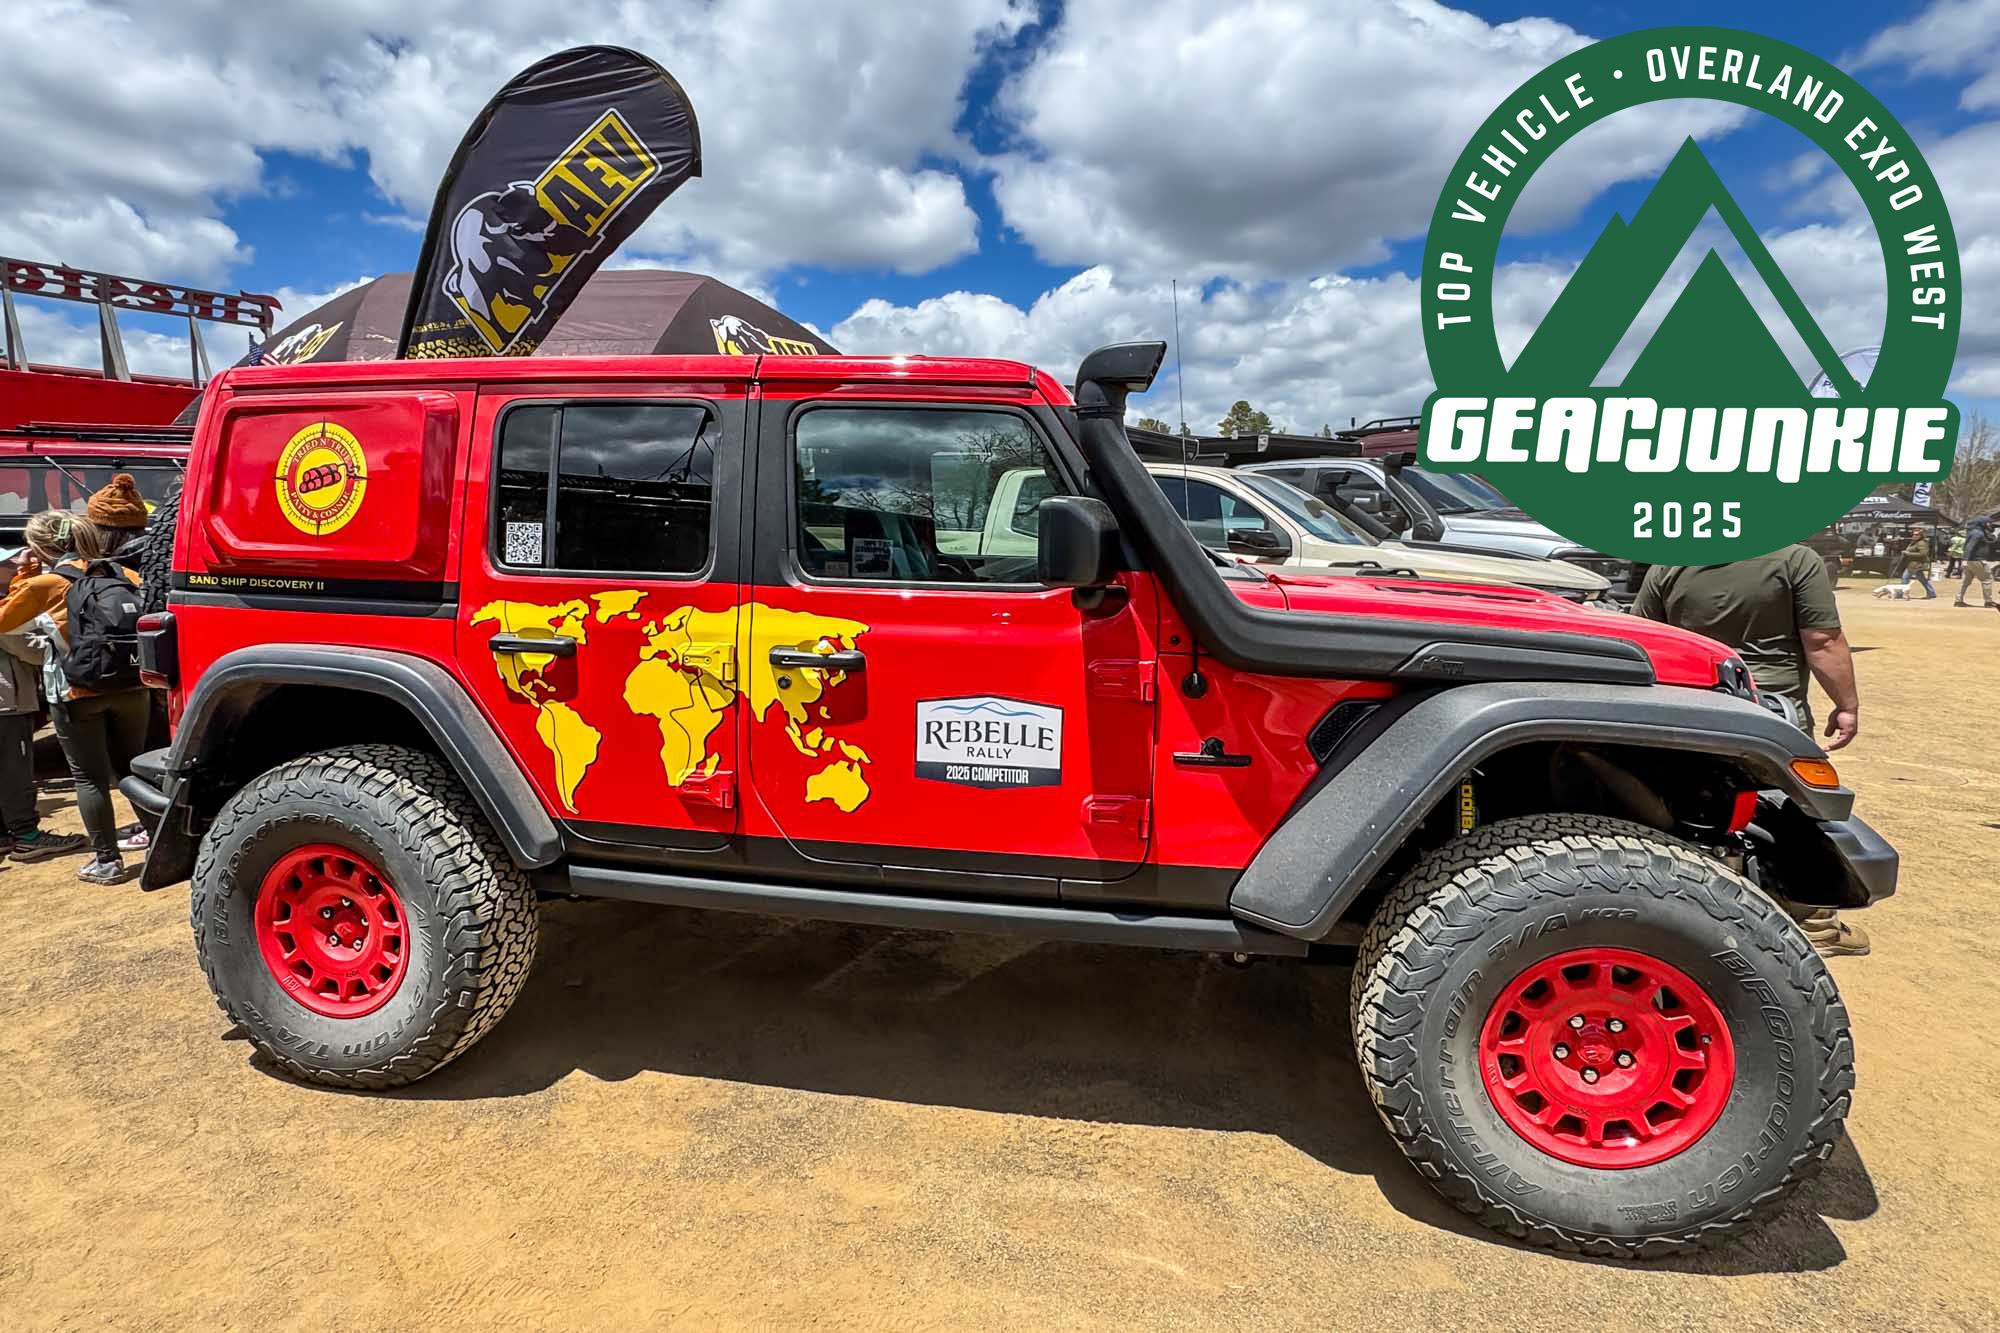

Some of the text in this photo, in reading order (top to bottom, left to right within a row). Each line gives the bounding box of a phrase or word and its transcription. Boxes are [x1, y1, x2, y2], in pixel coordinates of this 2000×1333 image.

[541, 122, 648, 230] AEV
[293, 439, 319, 464] TRIED
[331, 440, 352, 464] TRUE
[290, 492, 314, 516] PATTY
[312, 511, 319, 519] &
[189, 575, 324, 590] SAND SHIP DISCOVERY II
[925, 720, 1055, 751] REBELLE
[967, 746, 1012, 759] RALLY
[946, 765, 1029, 784] 2025 COMPETITOR
[1688, 949, 1796, 1209] BFGoodrich
